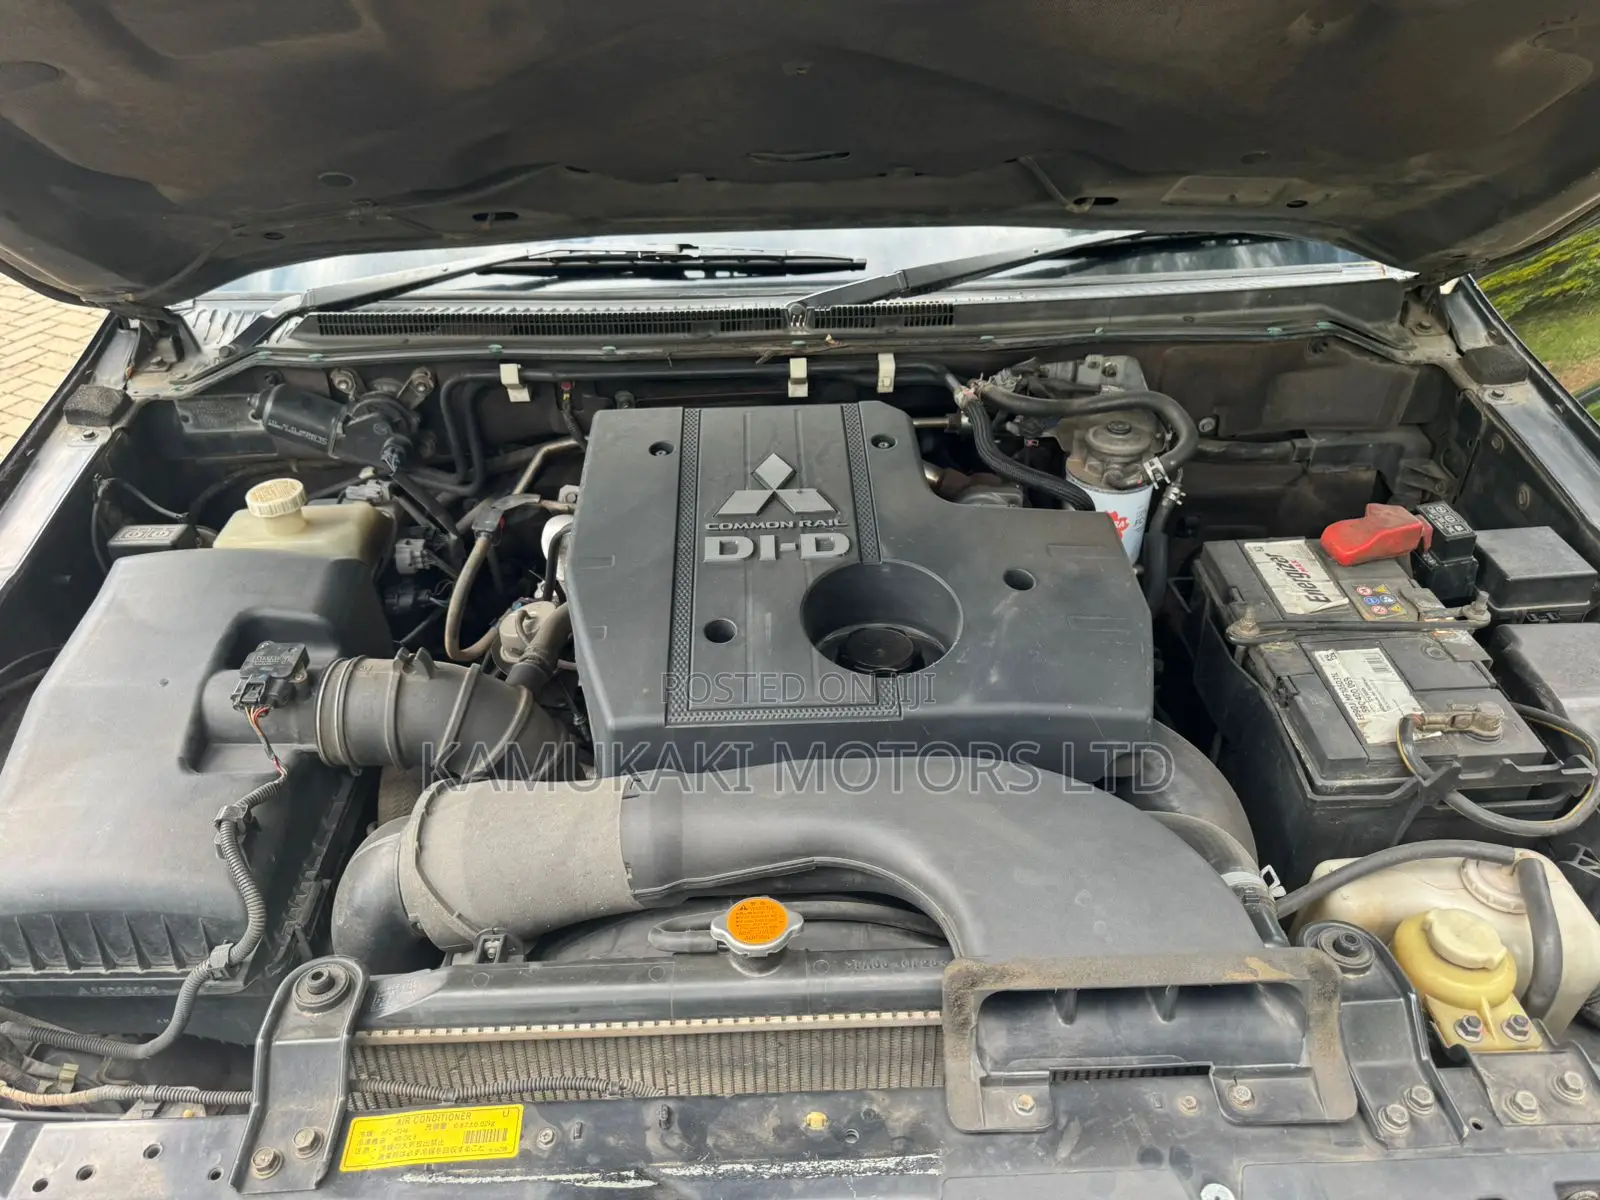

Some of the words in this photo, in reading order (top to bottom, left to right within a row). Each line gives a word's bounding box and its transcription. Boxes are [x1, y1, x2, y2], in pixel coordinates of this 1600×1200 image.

[704, 520, 794, 531] COMMON
[799, 517, 848, 528] RAIL
[704, 532, 851, 562] DI-D
[1264, 552, 1332, 604] Energizer
[396, 1115, 411, 1126] AIR
[413, 1111, 472, 1125] CONDITIONER
